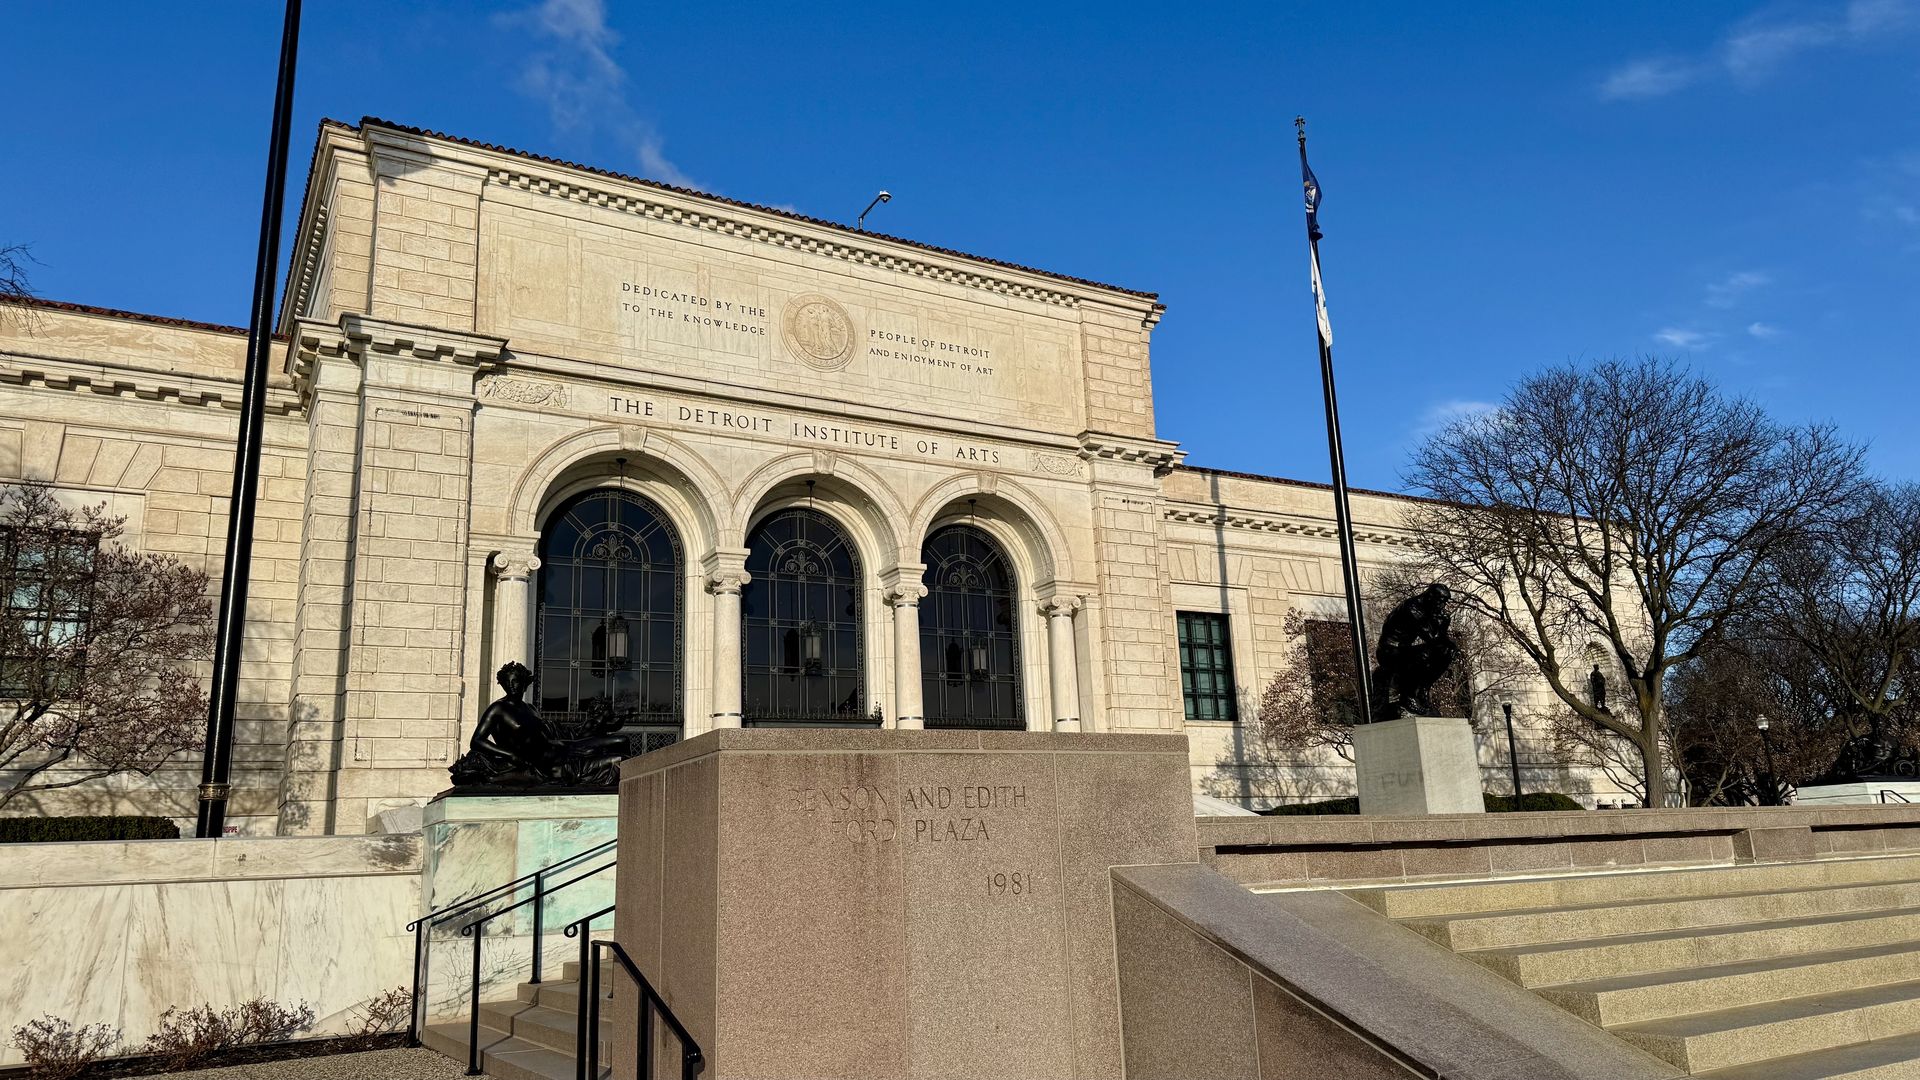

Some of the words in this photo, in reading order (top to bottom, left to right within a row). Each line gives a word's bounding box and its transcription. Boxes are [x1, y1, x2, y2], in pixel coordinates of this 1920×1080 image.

[622, 282, 708, 307] DEDICATED
[716, 300, 733, 311] BY
[739, 304, 766, 318] THE
[870, 329, 916, 346] PEOPLE
[921, 338, 936, 349] OF
[940, 342, 990, 359] DETROIT
[622, 302, 641, 313] TO
[649, 307, 674, 320] THE
[683, 313, 766, 336] KNOWLEDGE
[869, 347, 890, 358] AND
[894, 351, 956, 370] ENJOYMENT
[960, 363, 972, 372] OF
[976, 366, 994, 376] ART
[610, 396, 654, 417] THE
[679, 406, 773, 432] DETROIT
[794, 422, 899, 450] INSTITUTE
[916, 440, 939, 455] OF
[955, 446, 1000, 464] ARTS
[788, 785, 889, 812] BENSON
[903, 786, 951, 810] AND
[964, 786, 1027, 809] EDITH
[831, 818, 897, 843] FORD
[915, 818, 990, 842] PLAZA
[986, 871, 1033, 896] 1981
